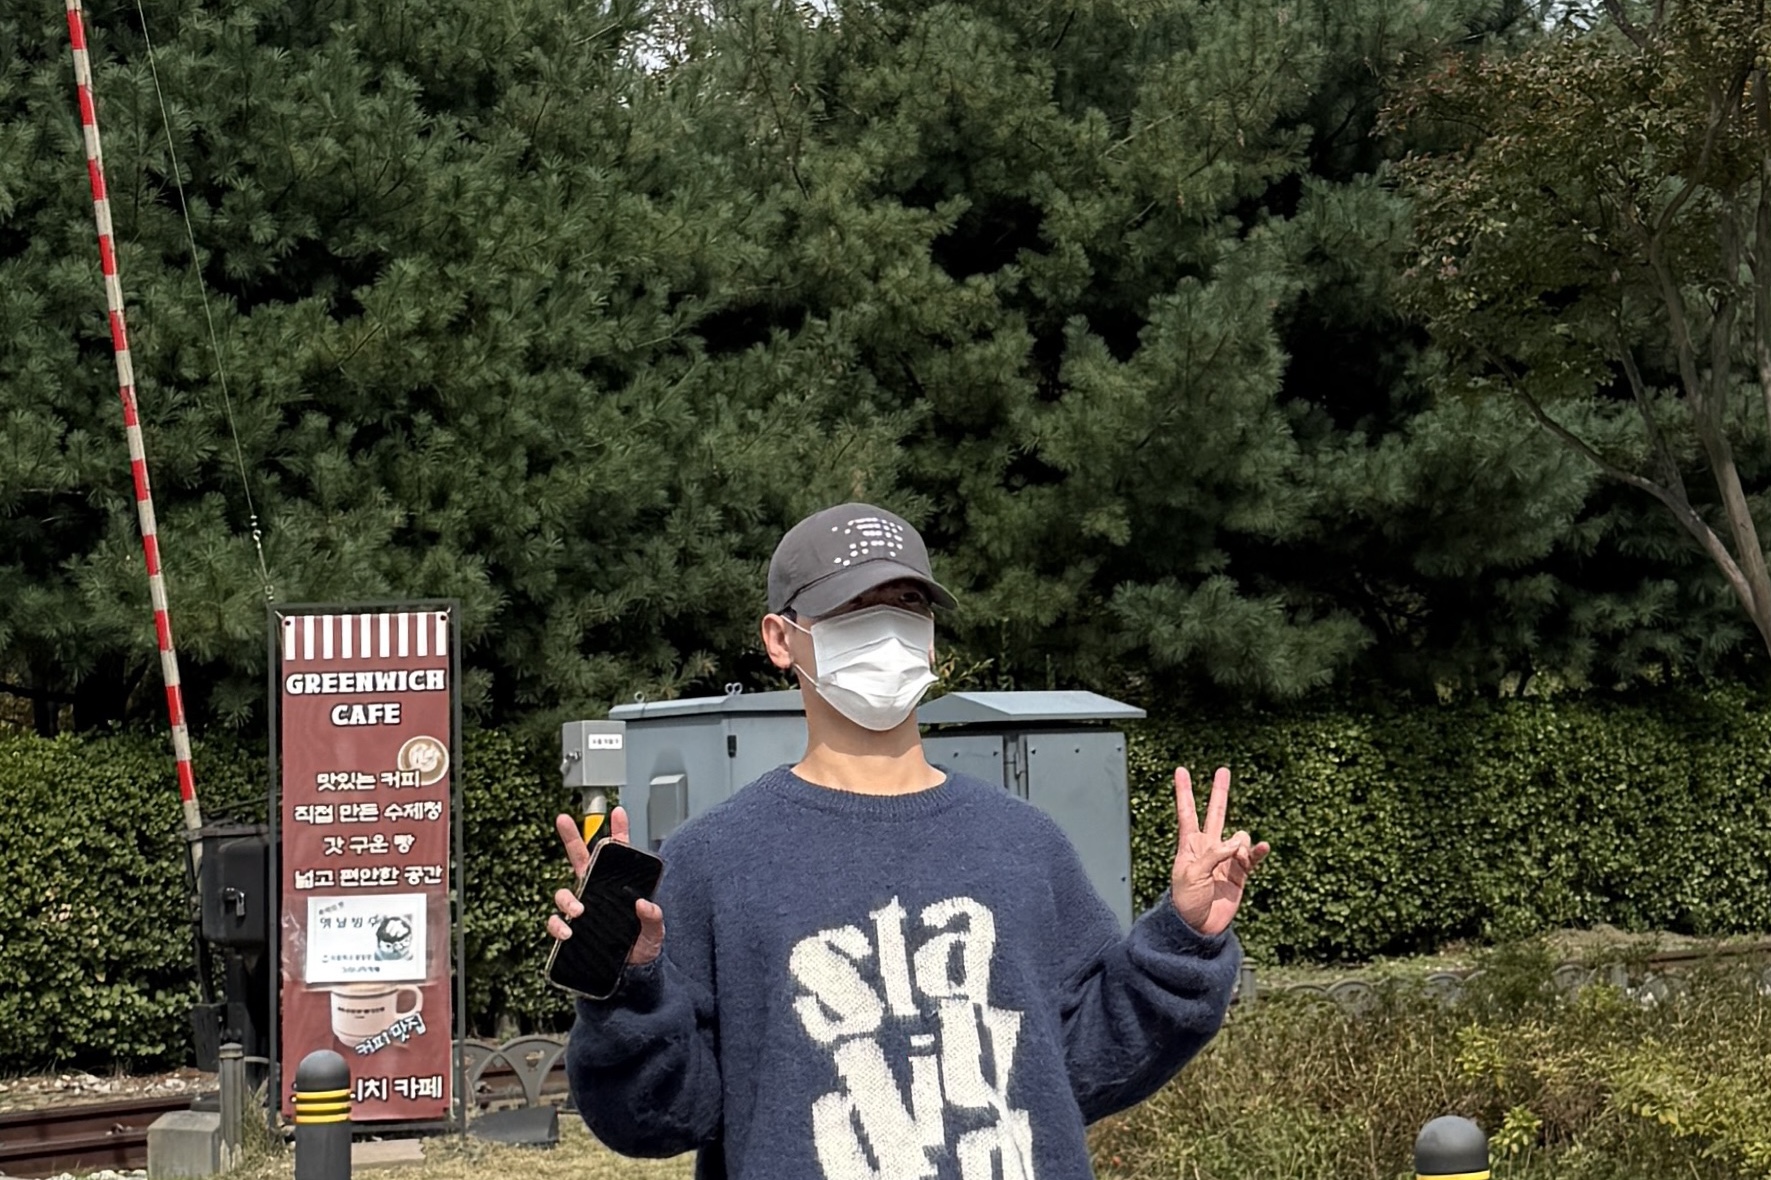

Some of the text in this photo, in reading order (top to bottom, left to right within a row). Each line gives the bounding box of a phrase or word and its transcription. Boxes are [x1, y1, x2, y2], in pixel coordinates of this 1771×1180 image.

[285, 669, 446, 695] GREENWICH
[331, 703, 401, 726] CAFE
[316, 770, 420, 792] 맛있는 커피
[294, 801, 442, 824] 직접 만든 수제청
[323, 833, 416, 855] 갓 구운 빵
[294, 864, 443, 889] 넓고 편안한 공간
[355, 1013, 427, 1055] 커피 맛집
[394, 1075, 443, 1099] 카페
